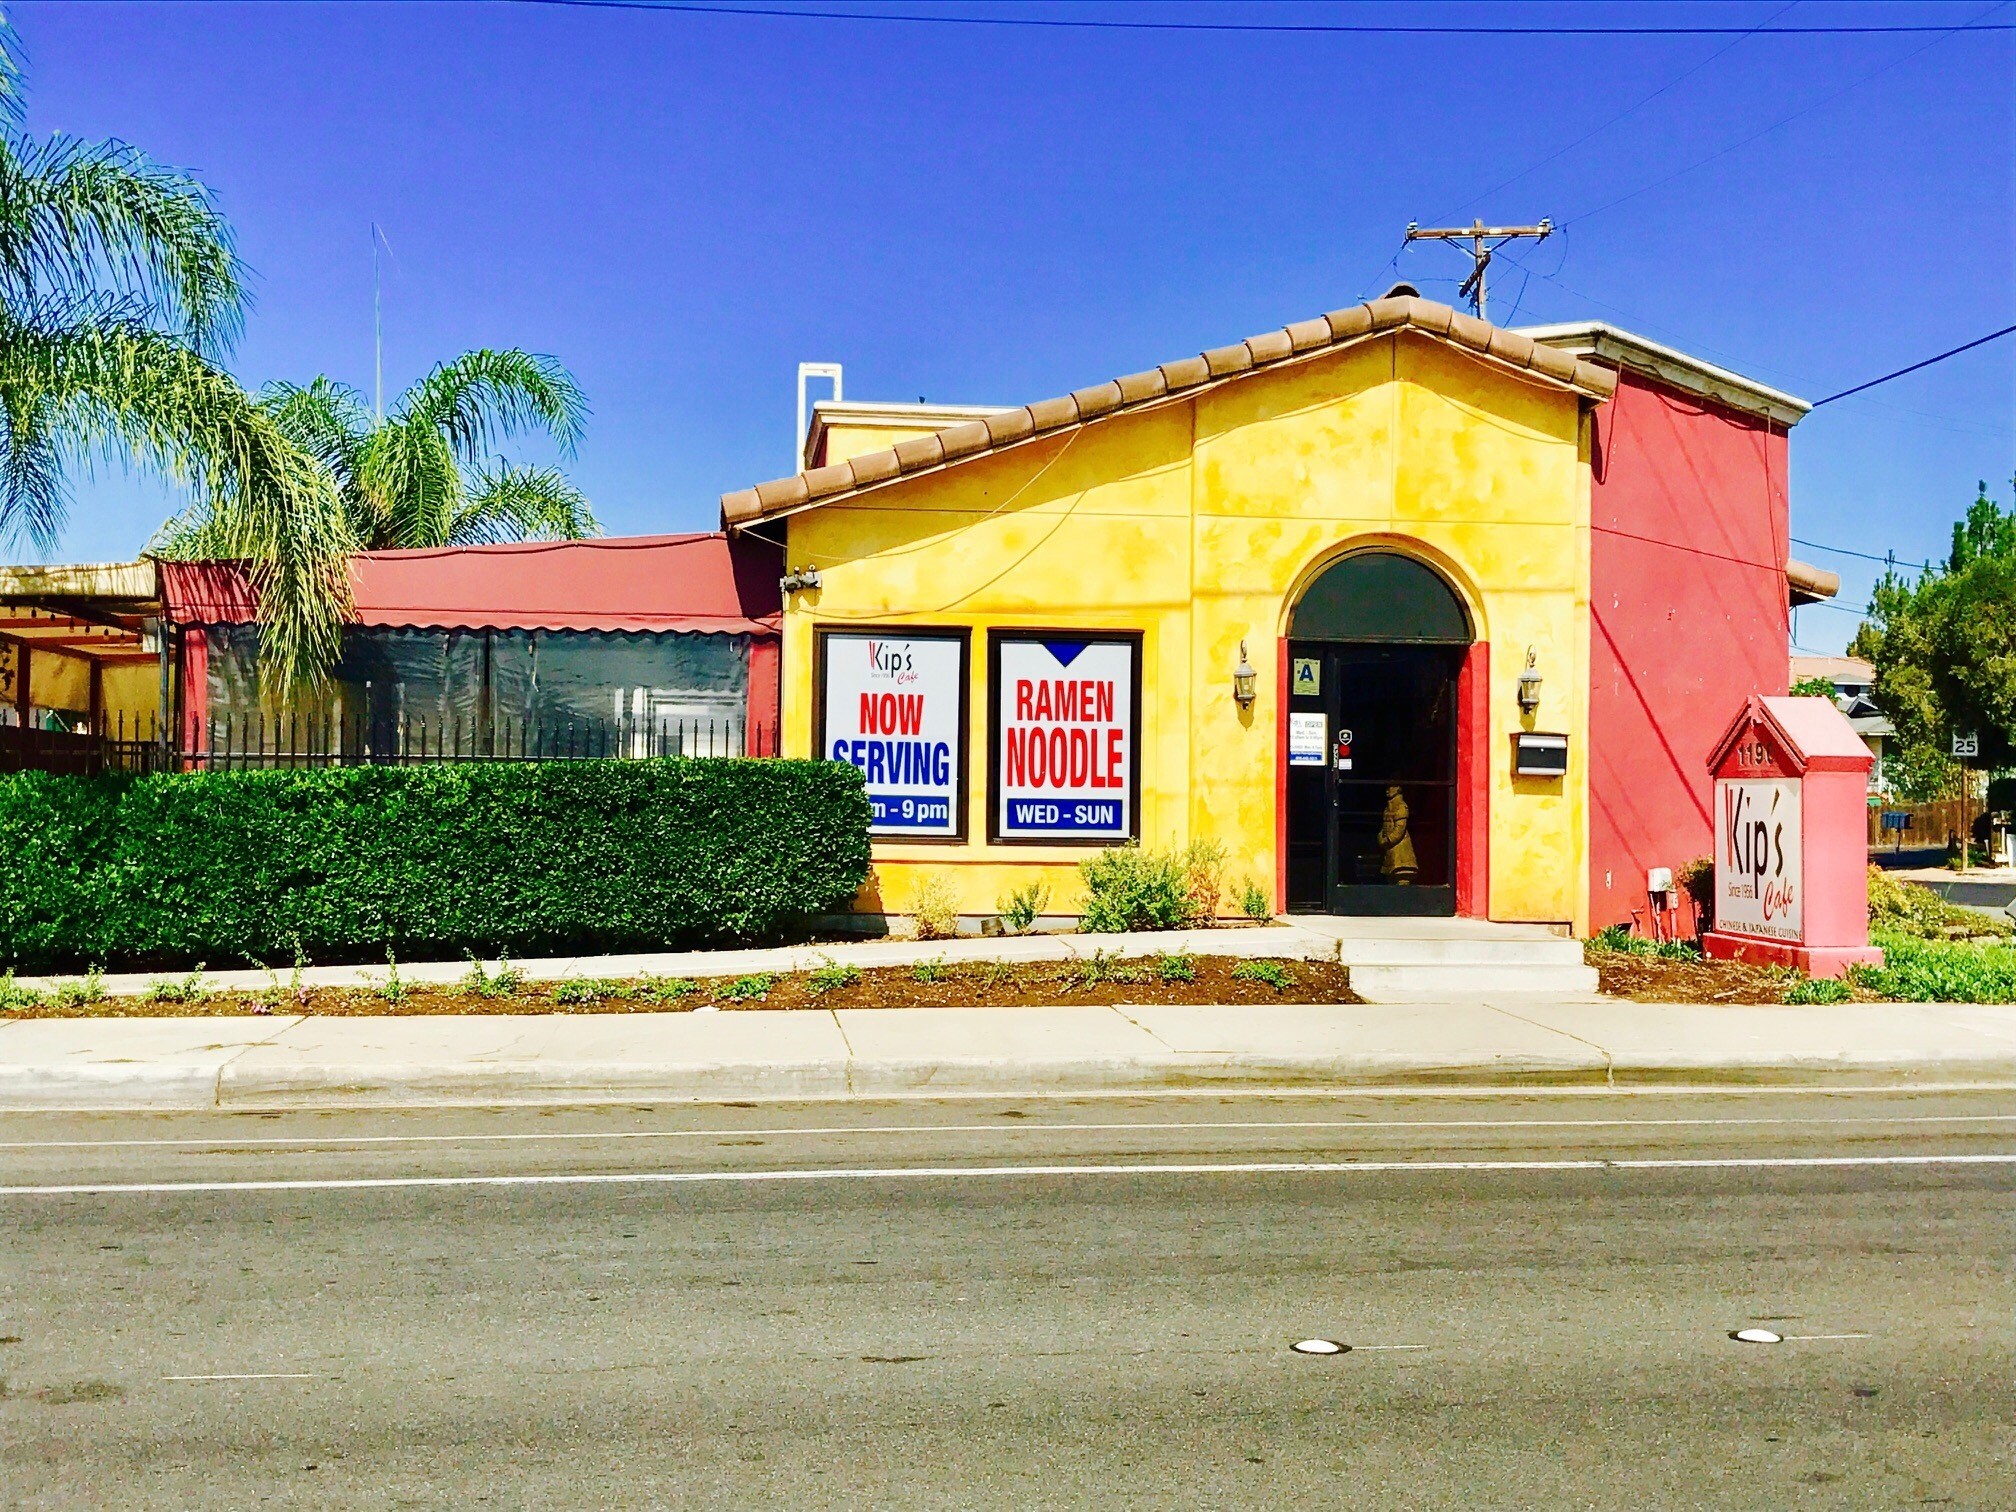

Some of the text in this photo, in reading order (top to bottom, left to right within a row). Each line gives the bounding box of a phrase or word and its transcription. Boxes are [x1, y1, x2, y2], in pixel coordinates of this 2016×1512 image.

[869, 641, 912, 678] Kip's
[1299, 664, 1314, 681] A
[897, 670, 919, 685] Cafe
[860, 693, 924, 735] NOW
[1017, 680, 1113, 722] RAMEN
[1007, 727, 1123, 788] NOODLE
[1955, 740, 1976, 753] 25
[1016, 805, 1059, 824] WED
[1075, 805, 1113, 825] SUN
[1725, 783, 1784, 899] Kip's
[1728, 882, 1741, 898] Since
[1763, 877, 1793, 921] Cafe
[1742, 922, 1748, 931] &
